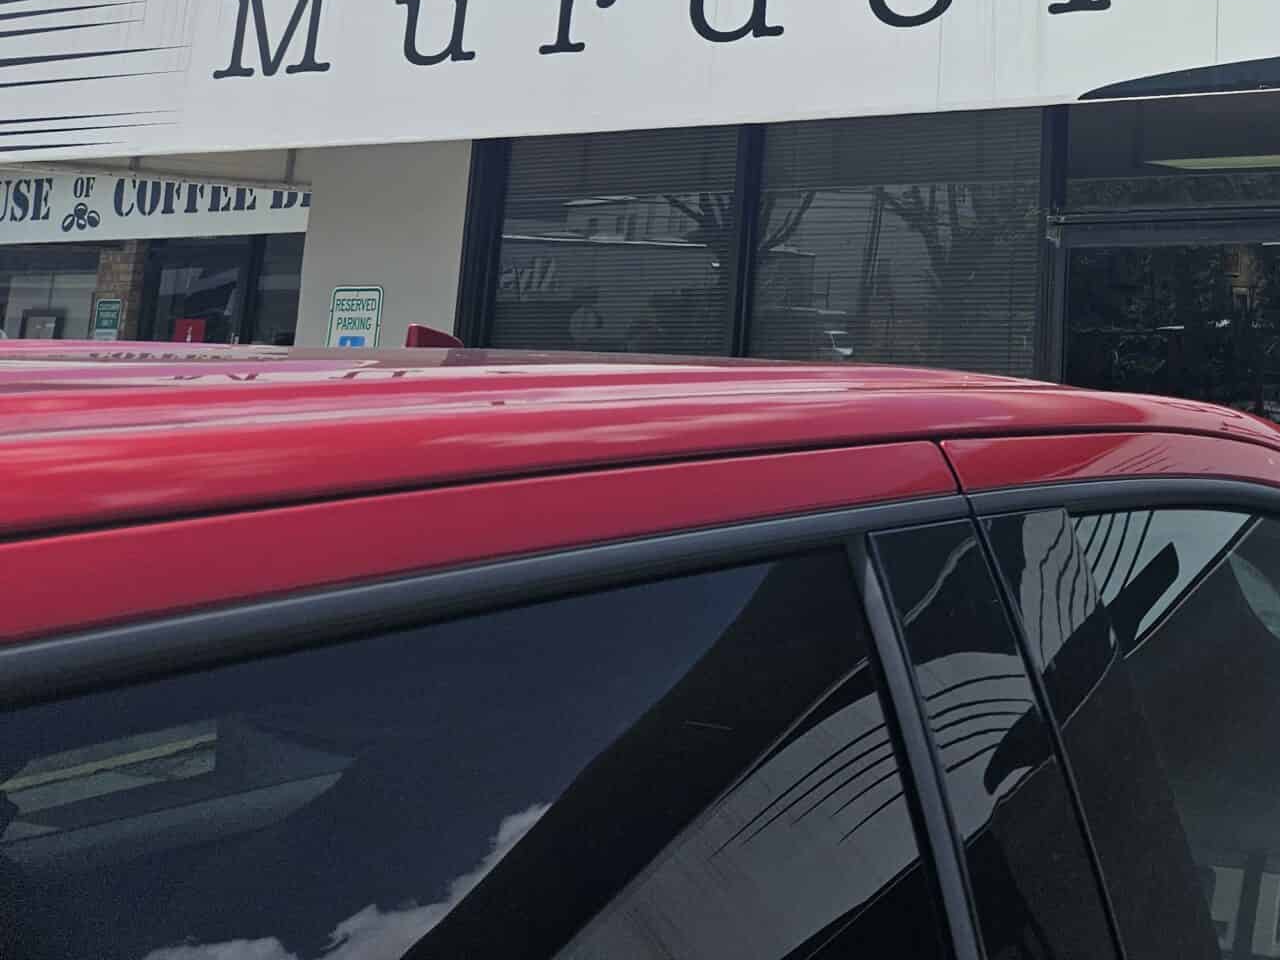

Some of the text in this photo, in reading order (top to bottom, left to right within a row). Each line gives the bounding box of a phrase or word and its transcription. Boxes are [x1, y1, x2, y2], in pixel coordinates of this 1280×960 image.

[73, 176, 96, 198] OF
[335, 297, 377, 313] RESERVED
[336, 316, 373, 331] PARKING
